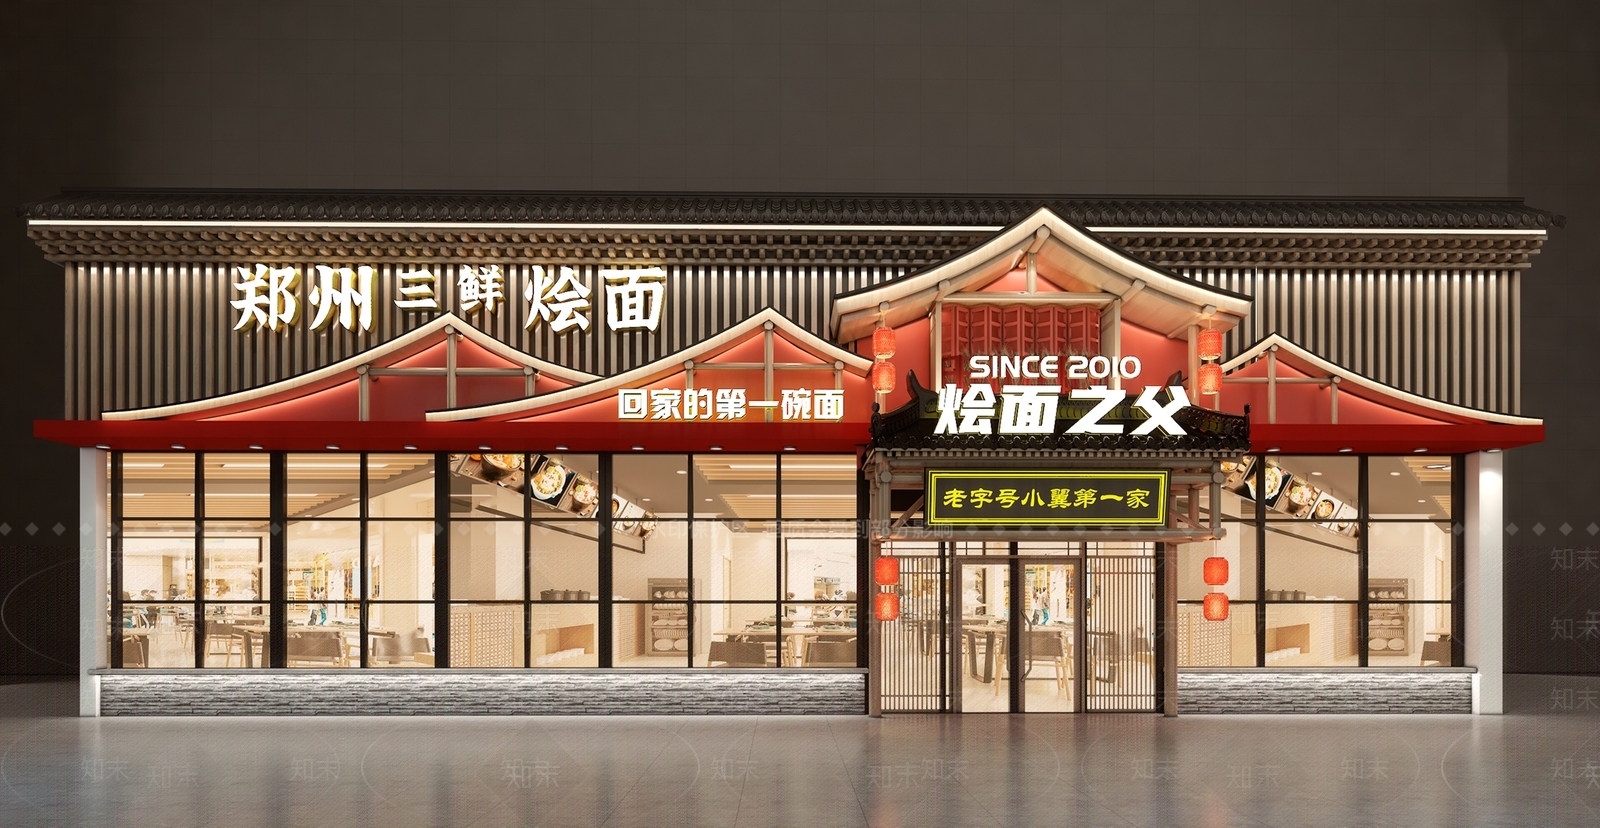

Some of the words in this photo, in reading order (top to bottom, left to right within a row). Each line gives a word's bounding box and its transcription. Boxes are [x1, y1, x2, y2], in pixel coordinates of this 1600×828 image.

[230, 262, 666, 334] 郑州三鲜烩面
[969, 355, 1059, 379] SINCE
[1068, 355, 1142, 379] 2010
[617, 387, 846, 421] 回家的第一碗面
[932, 382, 1192, 437] 烩面之父
